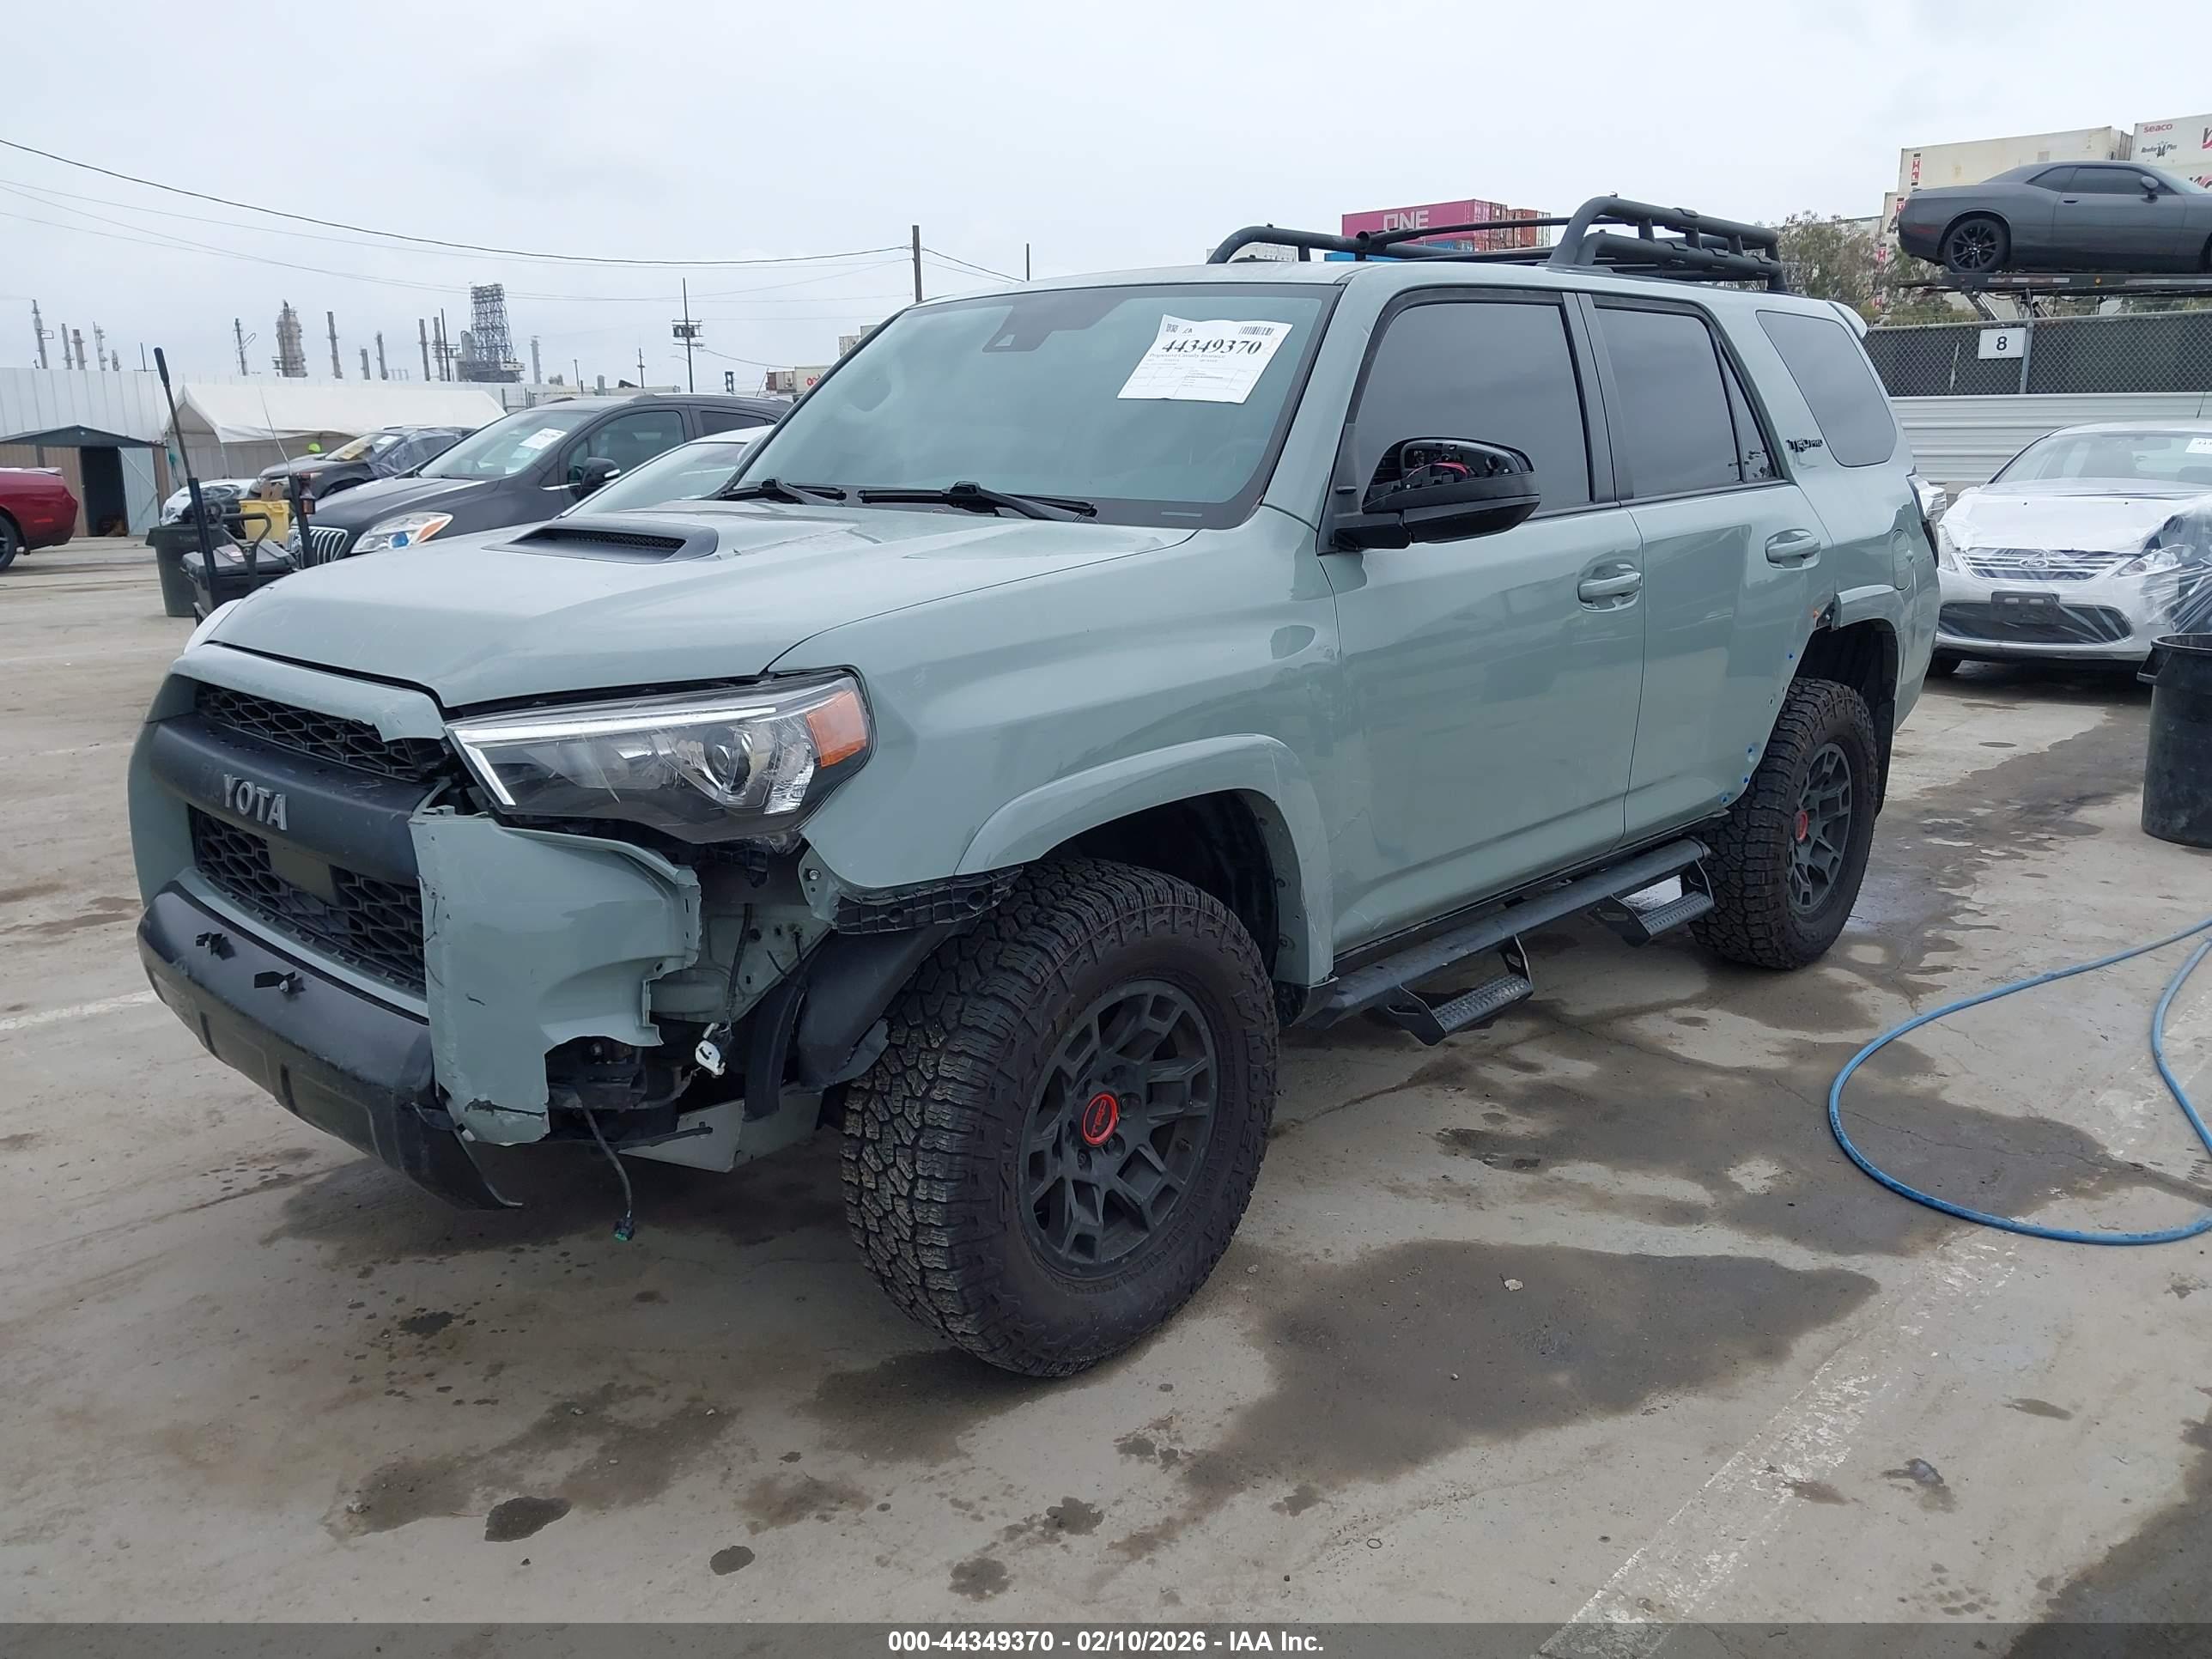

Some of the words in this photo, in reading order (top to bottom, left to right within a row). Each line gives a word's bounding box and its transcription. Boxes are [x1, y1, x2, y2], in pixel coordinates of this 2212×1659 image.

[2143, 123, 2173, 134] seaco
[1382, 210, 1430, 233] ONE
[1162, 338, 1262, 355] 44349370
[1996, 336, 2008, 351] 8
